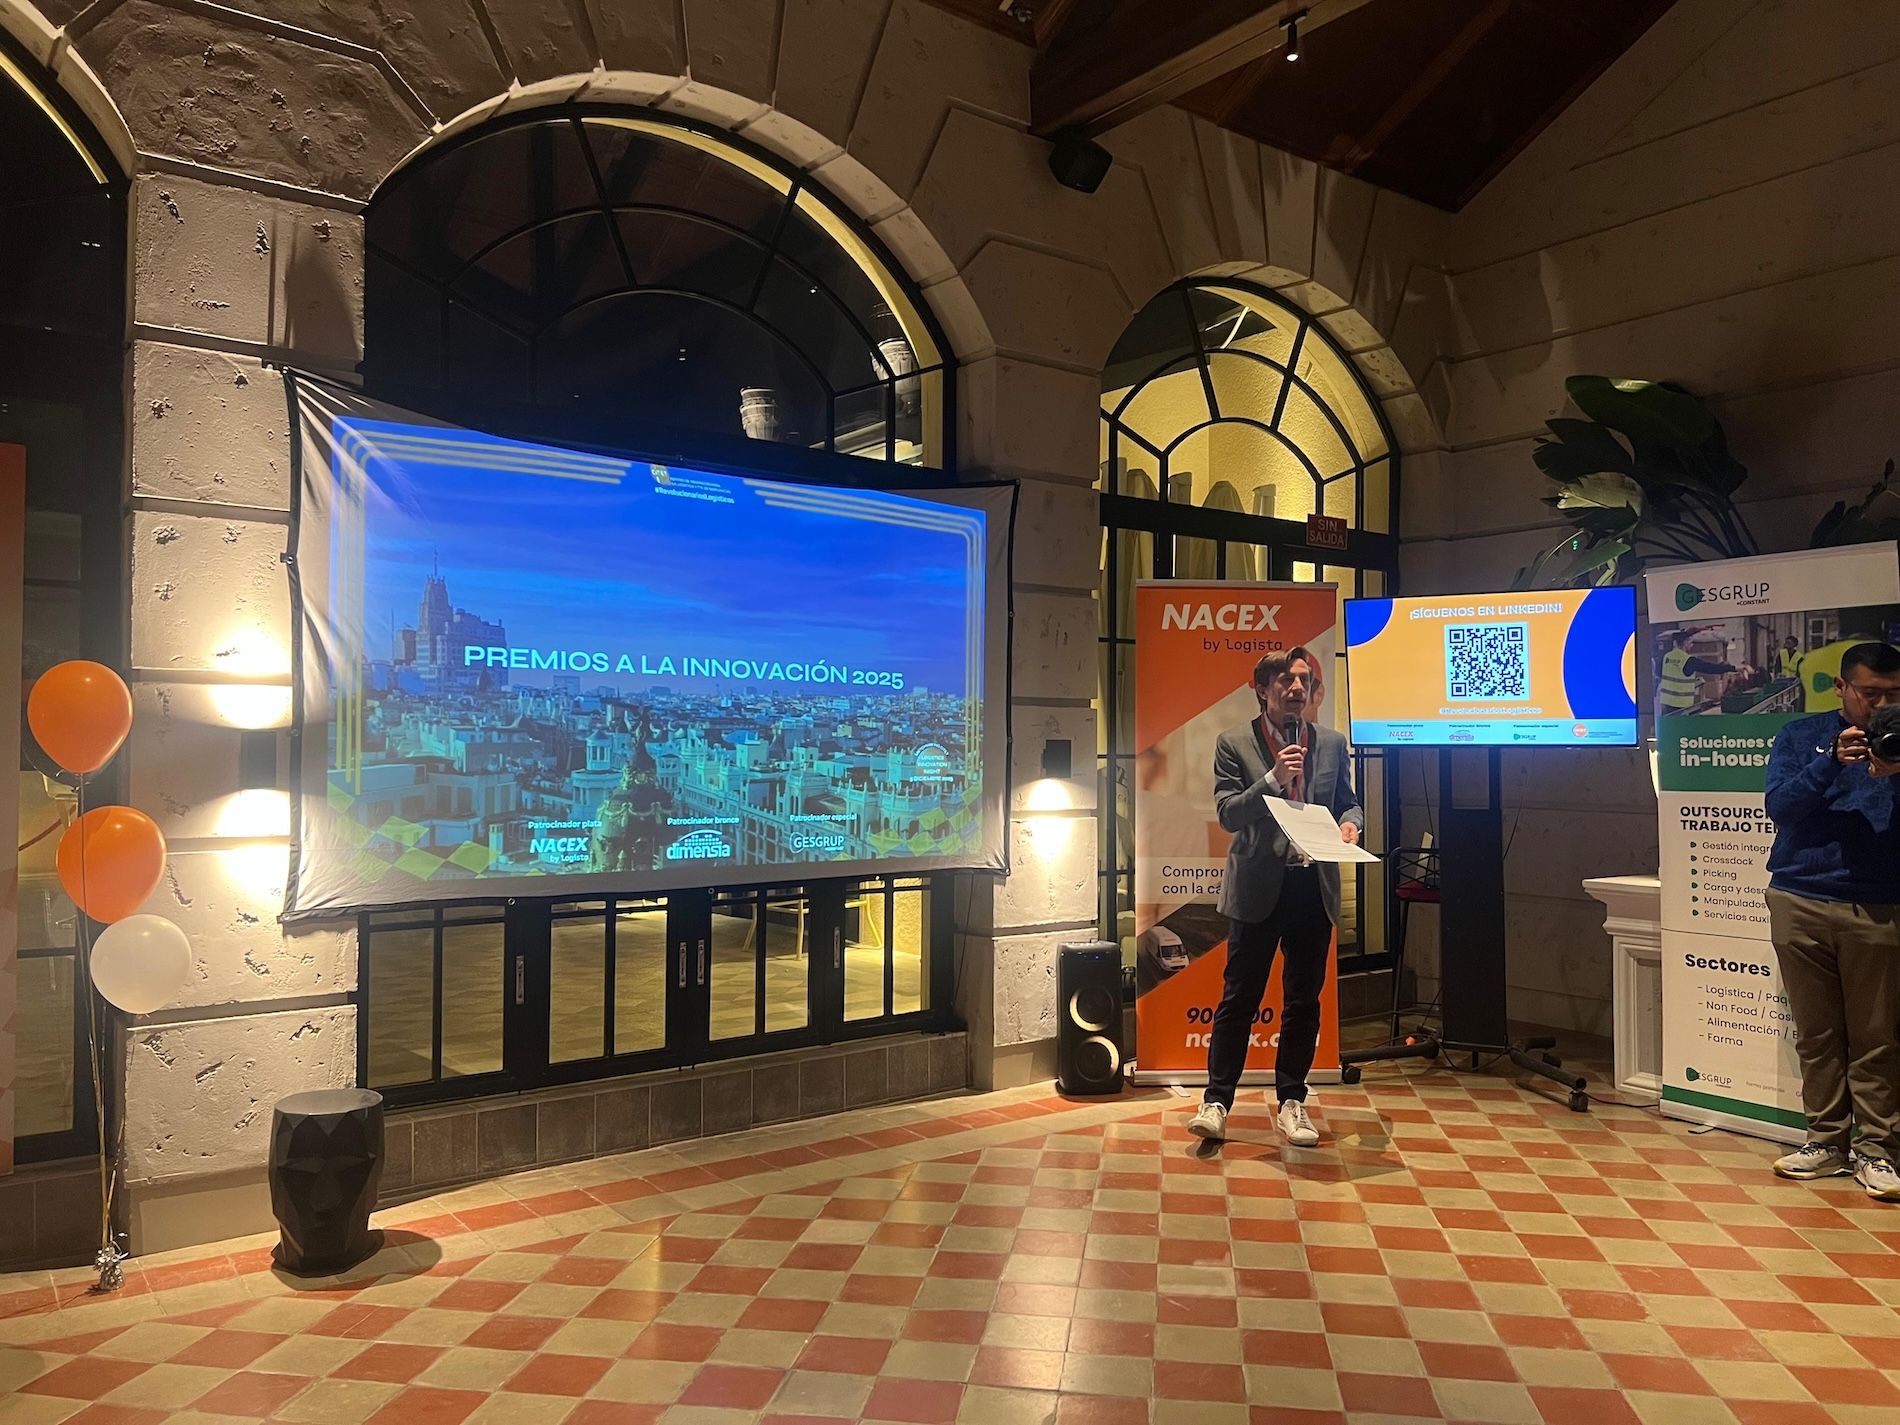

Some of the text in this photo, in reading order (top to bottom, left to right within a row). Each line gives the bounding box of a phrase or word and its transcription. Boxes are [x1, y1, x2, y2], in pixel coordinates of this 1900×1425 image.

[1317, 518, 1338, 531] SIN
[1309, 530, 1345, 546] SALIDA
[1682, 582, 1770, 604] GESGRUP
[1478, 606, 1495, 616] EN
[1498, 602, 1562, 616] LINKEDIN!
[1161, 603, 1282, 631] NACEX
[1203, 637, 1220, 652] by
[463, 645, 905, 691] PREMIOS A LA INNOVACIÓN 2025
[1680, 735, 1765, 749] Soluciones
[667, 816, 740, 826] Patrocinador bronce
[790, 813, 857, 822] Patrocinador especial
[528, 821, 581, 829] Patrocinador
[1680, 819, 1752, 833] TRABAJO
[529, 837, 589, 854] NACEX
[793, 835, 845, 849] GESGRUP
[1702, 841, 1739, 851] Gestión
[666, 842, 731, 860] dimensia
[550, 854, 560, 863] by
[1702, 855, 1754, 866] Crossdock
[1703, 869, 1737, 881] Picking
[1162, 885, 1188, 894] con
[1192, 882, 1203, 894] la
[1703, 882, 1734, 894] Carga
[1736, 886, 1742, 895] y
[1704, 896, 1767, 909] Manipulados
[1704, 909, 1747, 922] Servicios
[1684, 953, 1772, 977] Sectores
[1705, 984, 1755, 1000] Logística
[1706, 1000, 1728, 1012] Non
[1731, 1004, 1758, 1016] Food
[1707, 1016, 1781, 1037] Alimentación
[1707, 1033, 1743, 1047] Farma
